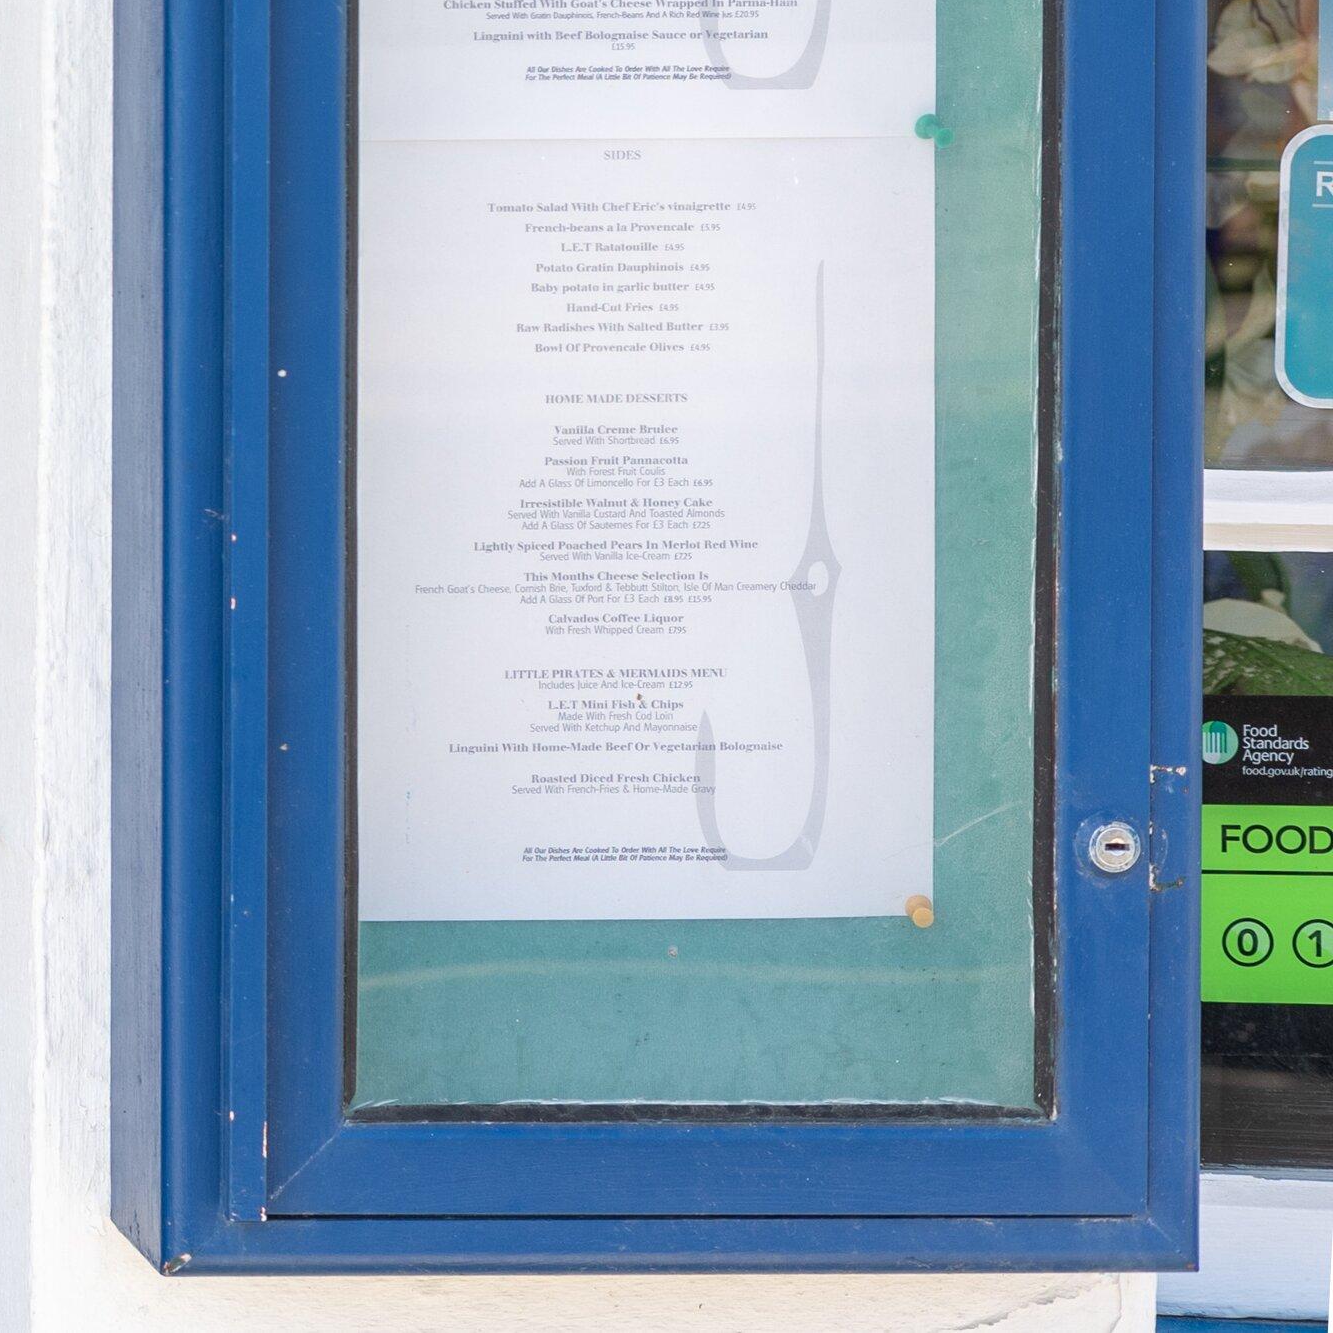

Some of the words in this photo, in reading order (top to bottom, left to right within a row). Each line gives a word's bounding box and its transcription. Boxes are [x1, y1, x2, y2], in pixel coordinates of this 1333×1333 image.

[473, 31, 524, 42] Linguini
[527, 31, 552, 40] with
[555, 30, 583, 40] Beef
[585, 30, 649, 41] Bolognaise
[651, 31, 687, 40] Sauce
[705, 30, 769, 40] Vegetarian
[603, 150, 642, 160] SIDES
[487, 203, 534, 213] Tomato
[536, 202, 569, 212] Salad
[571, 202, 599, 212] With
[601, 202, 631, 212] Chef
[667, 202, 731, 212] vinaigrette
[630, 222, 695, 232] Provencale
[595, 242, 659, 252] Ratatouille
[535, 263, 574, 273] Potato
[576, 263, 615, 272] Gratin
[617, 262, 685, 272] Dauphinois
[625, 302, 654, 312] Fries
[534, 343, 563, 353] Bowl
[582, 342, 647, 352] Provencale
[649, 342, 685, 352] Olives
[545, 394, 583, 404] HOME
[586, 394, 623, 404] MADE
[625, 393, 688, 403] DESSERTS
[555, 425, 595, 435] Vanilla
[597, 425, 637, 434] Creme
[639, 424, 679, 434] Brulee
[544, 456, 588, 466] Passion
[591, 456, 620, 466] Fruit
[622, 455, 689, 465] Pannacotta
[520, 498, 583, 508] Irresistible
[586, 498, 628, 508] Walnut
[643, 498, 680, 510] Honey
[683, 497, 713, 507] Cake
[548, 614, 600, 624] Calvados
[601, 613, 641, 623] Coffee
[643, 613, 685, 625] Liquor
[504, 669, 549, 679] LITTLE
[551, 669, 604, 679] PIRATES
[619, 668, 688, 678] MERMAIDS
[691, 668, 727, 678] MENU
[581, 700, 609, 709] Mini
[611, 699, 636, 709] Fish
[650, 699, 684, 711] Chips
[1242, 724, 1278, 737] Food
[1242, 737, 1310, 750] Standards
[1242, 749, 1294, 765] Agency
[531, 774, 578, 783] Roasted
[580, 773, 614, 783] Diced
[617, 773, 650, 783] Fresh
[652, 773, 701, 783] Chicken
[1220, 824, 1333, 854] FOOD
[1237, 928, 1259, 957] 0
[1307, 929, 1323, 958] 1
